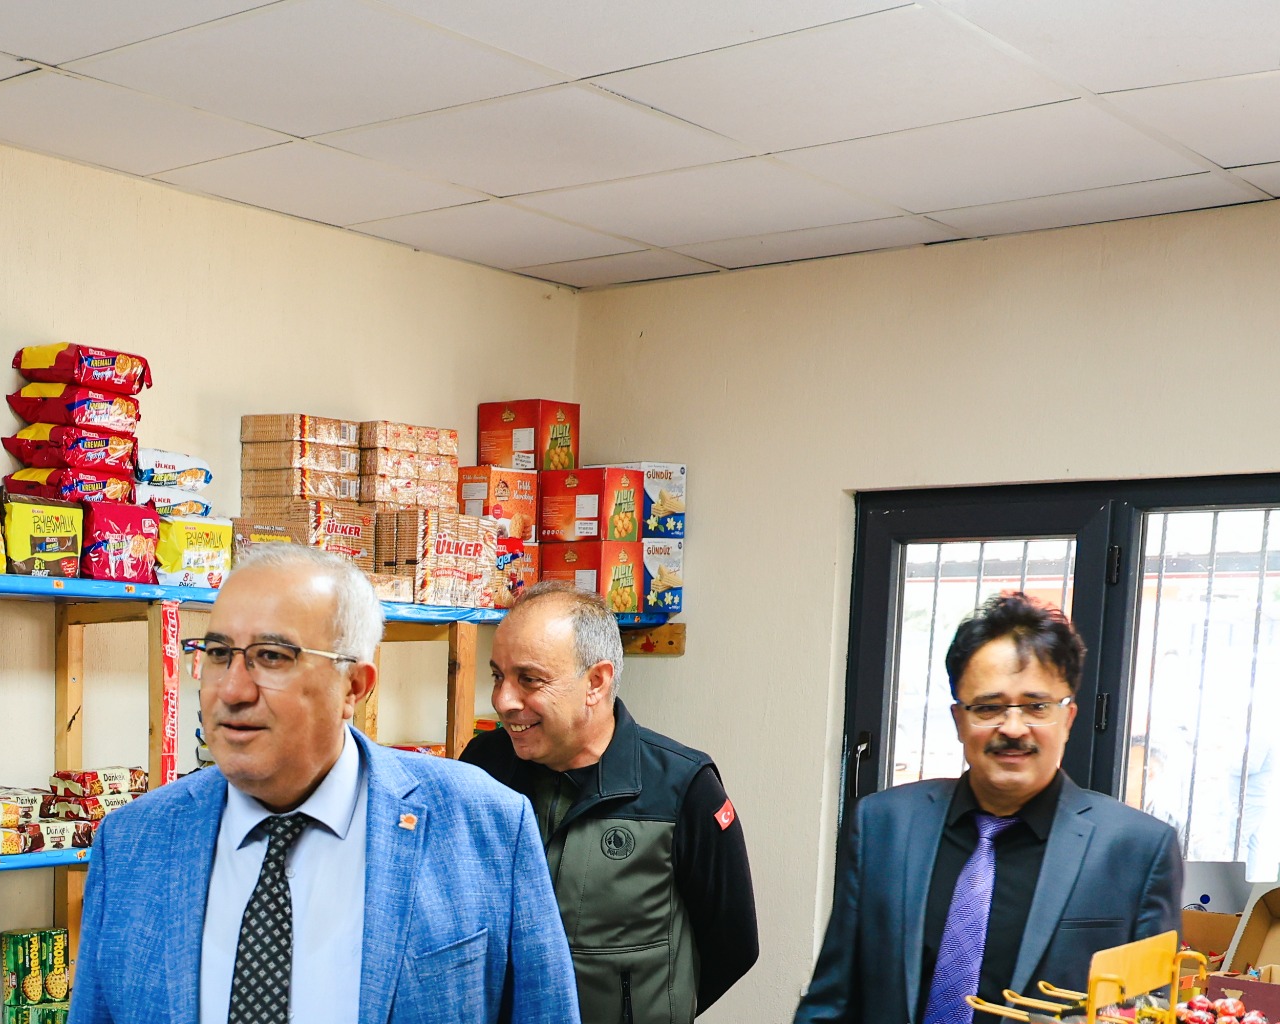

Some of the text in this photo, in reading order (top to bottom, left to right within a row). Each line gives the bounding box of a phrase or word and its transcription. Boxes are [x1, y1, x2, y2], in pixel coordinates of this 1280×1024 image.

[90, 357, 113, 367] KREMALI
[83, 439, 107, 449] KREMALI
[155, 461, 176, 470] ÜLKER
[646, 470, 672, 480] GÜNDÜZ
[82, 482, 103, 491] KREMALI
[325, 518, 362, 537] ÜLKER
[435, 533, 484, 557] ÜLKER
[646, 546, 671, 556] GÜNDÜZ
[166, 609, 179, 659] ÜLKER
[166, 689, 179, 739] ÜLKER
[103, 772, 126, 783] Dankek
[104, 796, 128, 806] Dankek
[46, 825, 70, 836] Dankek
